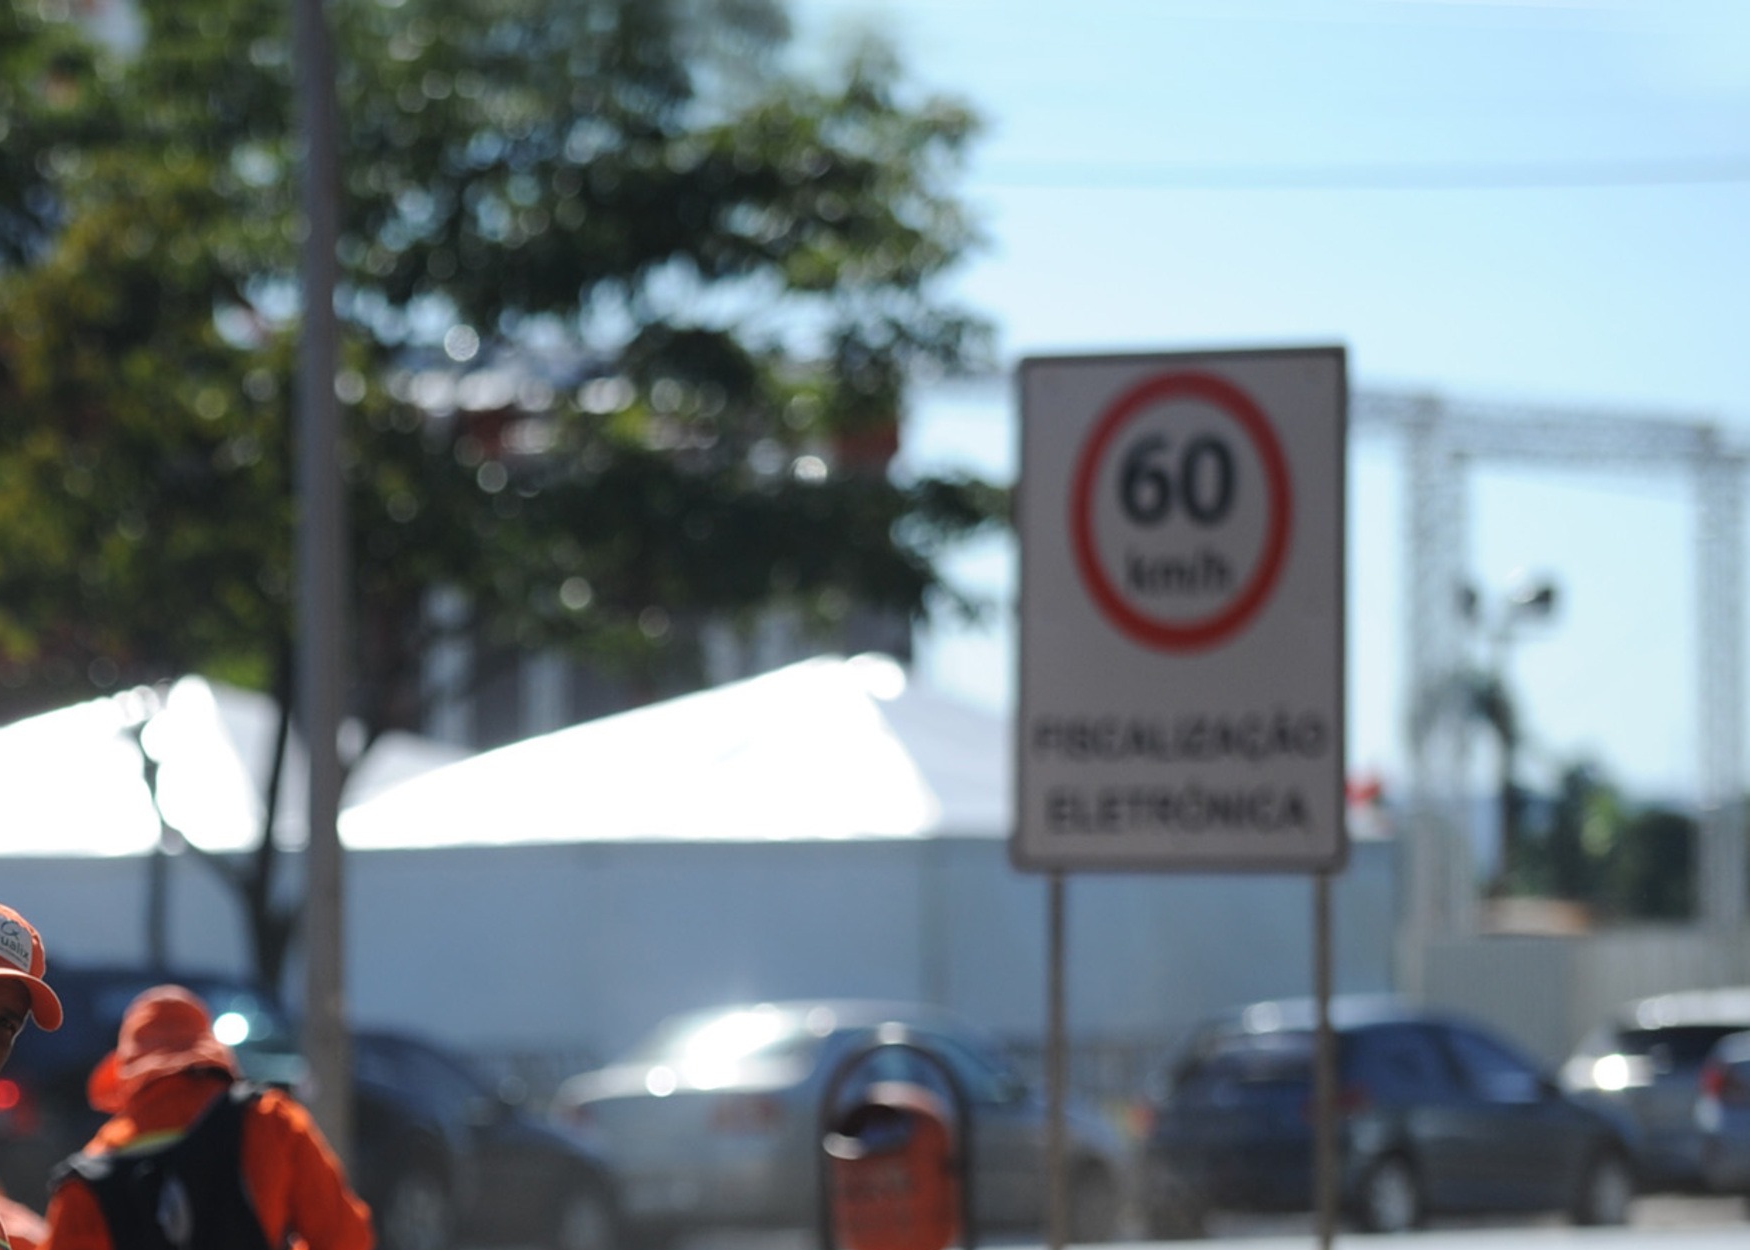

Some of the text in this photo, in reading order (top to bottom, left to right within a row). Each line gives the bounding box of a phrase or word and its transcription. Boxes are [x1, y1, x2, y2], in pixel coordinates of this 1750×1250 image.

[1118, 432, 1237, 527] 60
[1124, 546, 1233, 593] km/h
[1033, 707, 1328, 763] FISCALIZAÇÃO
[1045, 777, 1313, 833] ELETRÔNICA
